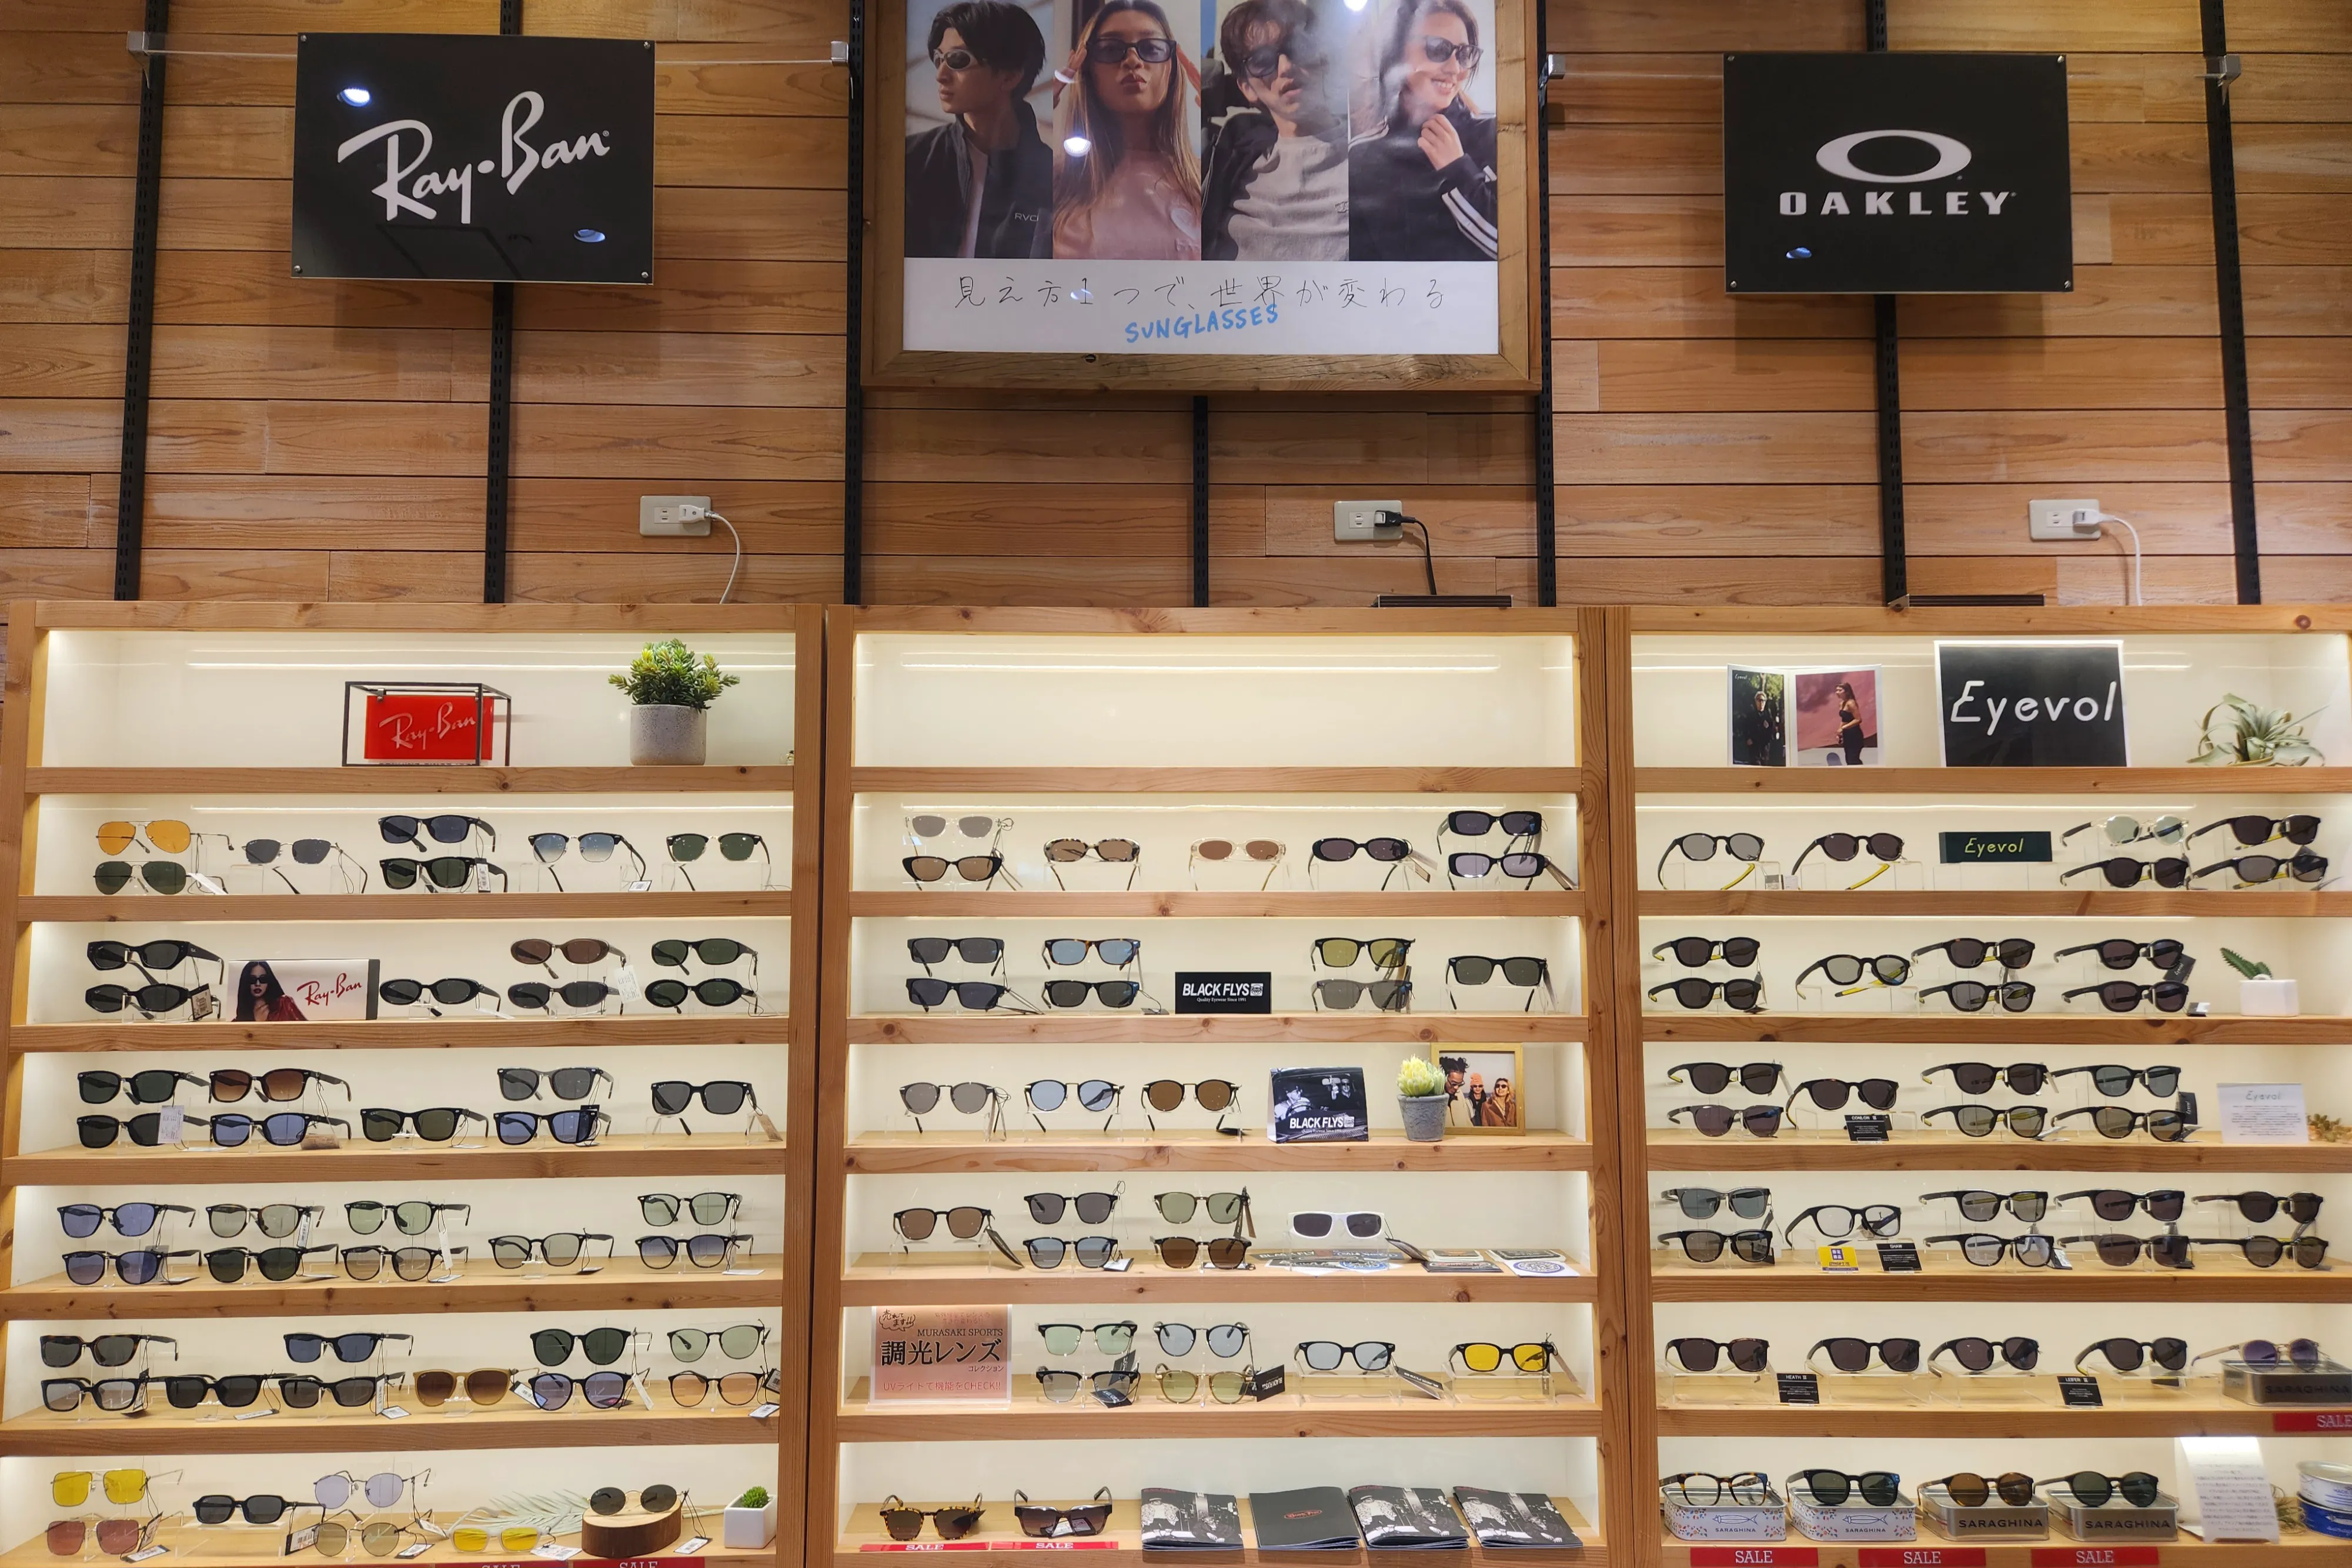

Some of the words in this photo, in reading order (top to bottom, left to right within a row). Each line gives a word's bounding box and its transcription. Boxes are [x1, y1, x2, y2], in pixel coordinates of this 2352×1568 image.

[1779, 191, 2010, 216] OAKLEY
[1124, 303, 1279, 343] SUNGLASSES
[1950, 680, 2116, 736] Eyevol
[1965, 838, 2024, 858] Eyevol
[1182, 983, 1221, 997] BLACK
[1222, 983, 1250, 997] FLYS
[2246, 1090, 2281, 1102] Eyevol
[1289, 1117, 1321, 1129] BLACK
[1322, 1116, 1344, 1128] FLYS
[883, 1309, 904, 1320] 売れて
[968, 1328, 1003, 1336] SPORTS
[880, 1338, 1002, 1366] 調光レンズ
[2265, 1385, 2350, 1394] SARAGHINA
[2316, 1414, 2352, 1428] SALE
[1958, 1518, 2044, 1529] SARAGHINA
[2084, 1519, 2170, 1529] SARAGHINA
[1735, 1550, 1773, 1564] SALE
[1903, 1551, 1941, 1564] SALE
[2076, 1550, 2114, 1564] SALE
